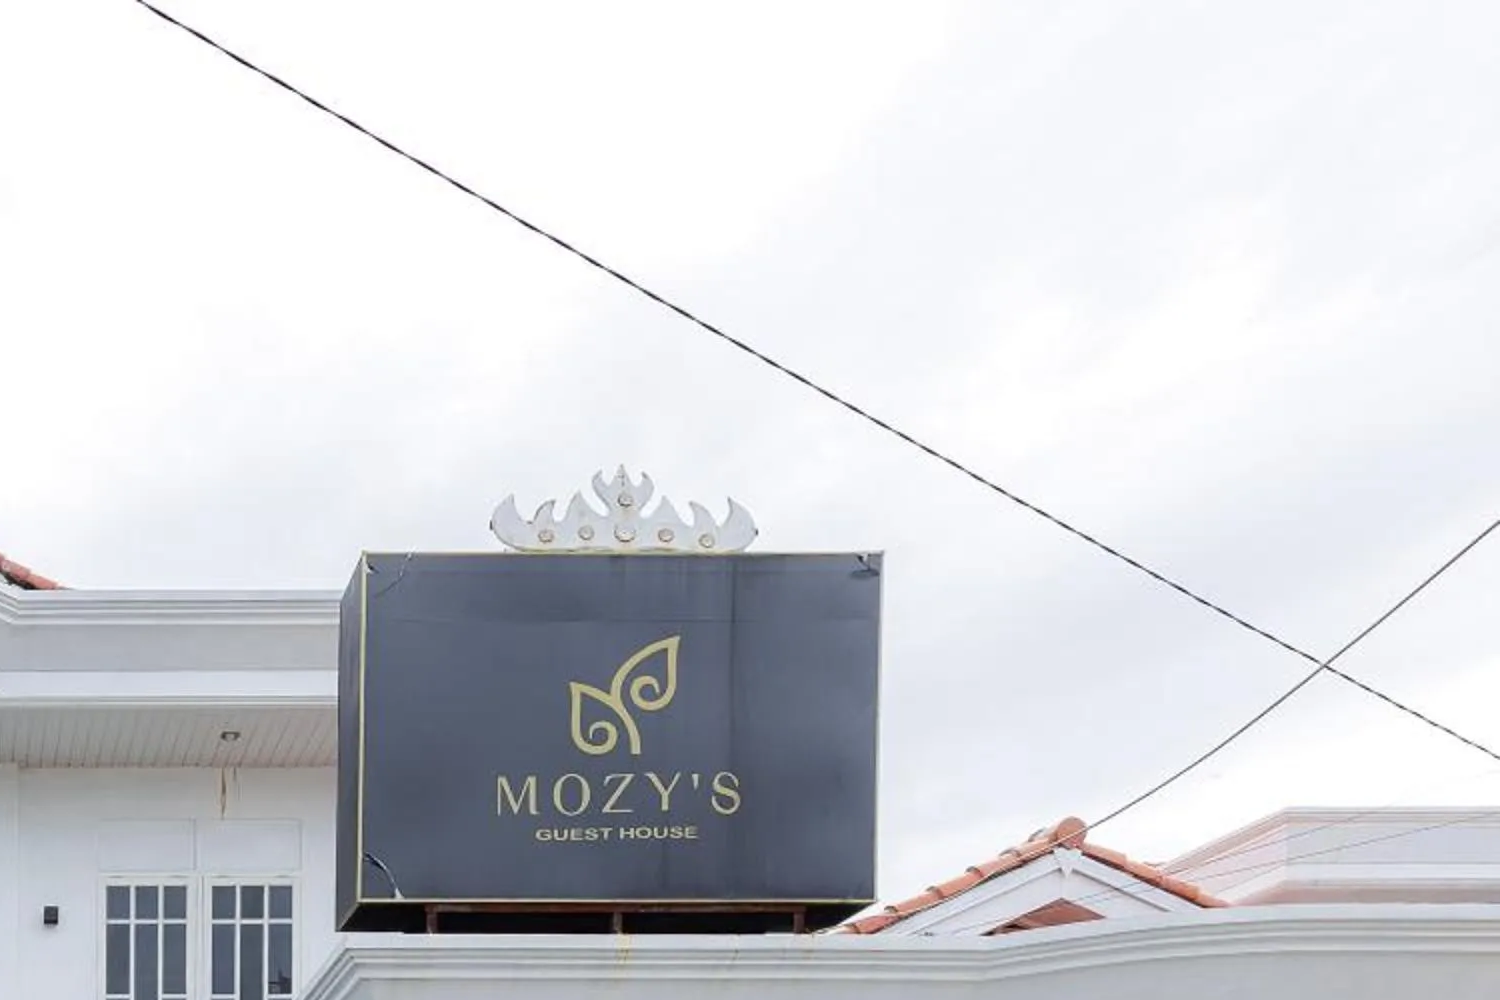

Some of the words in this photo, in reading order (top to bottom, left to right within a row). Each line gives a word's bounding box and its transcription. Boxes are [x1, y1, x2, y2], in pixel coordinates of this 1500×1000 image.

[497, 772, 741, 817] MOZY'S
[534, 827, 612, 841] GUEST
[619, 825, 699, 840] HOUSE
